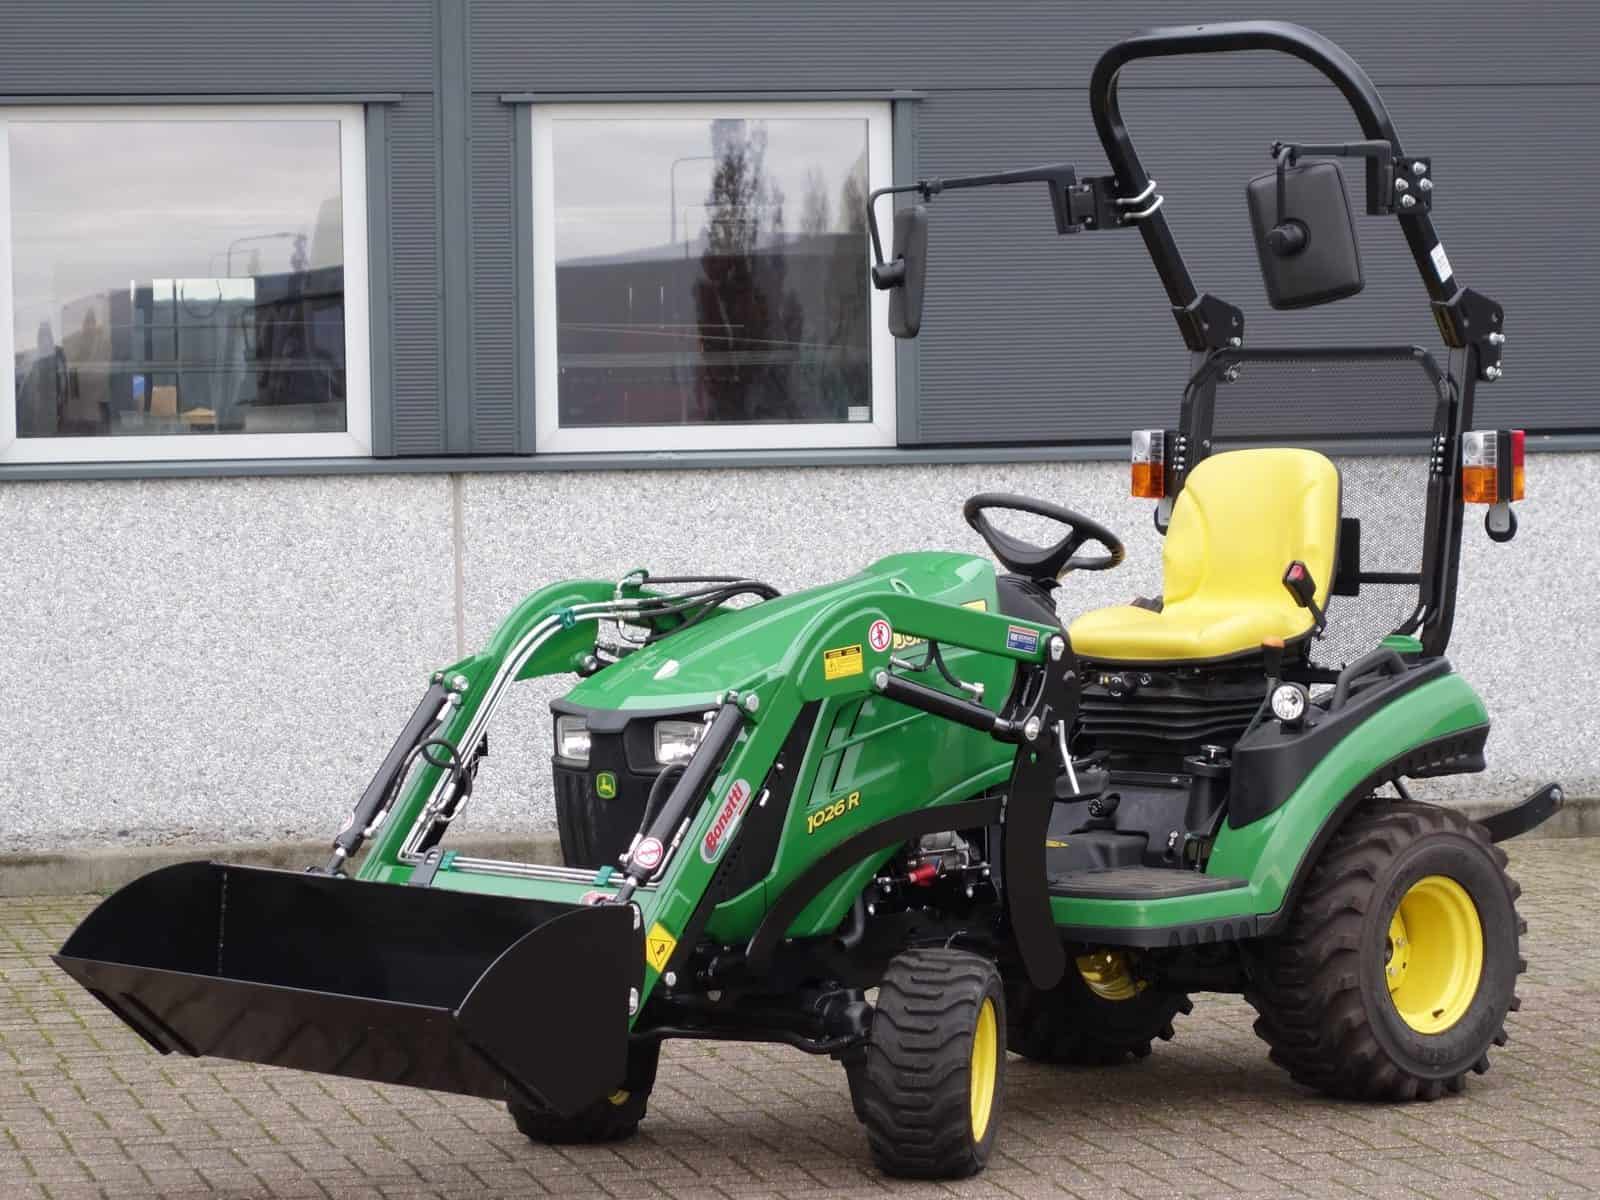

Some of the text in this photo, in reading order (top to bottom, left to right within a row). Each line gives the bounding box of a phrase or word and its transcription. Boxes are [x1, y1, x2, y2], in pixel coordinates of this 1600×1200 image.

[706, 781, 743, 852] Bonatti
[807, 791, 860, 834] 1026 R
